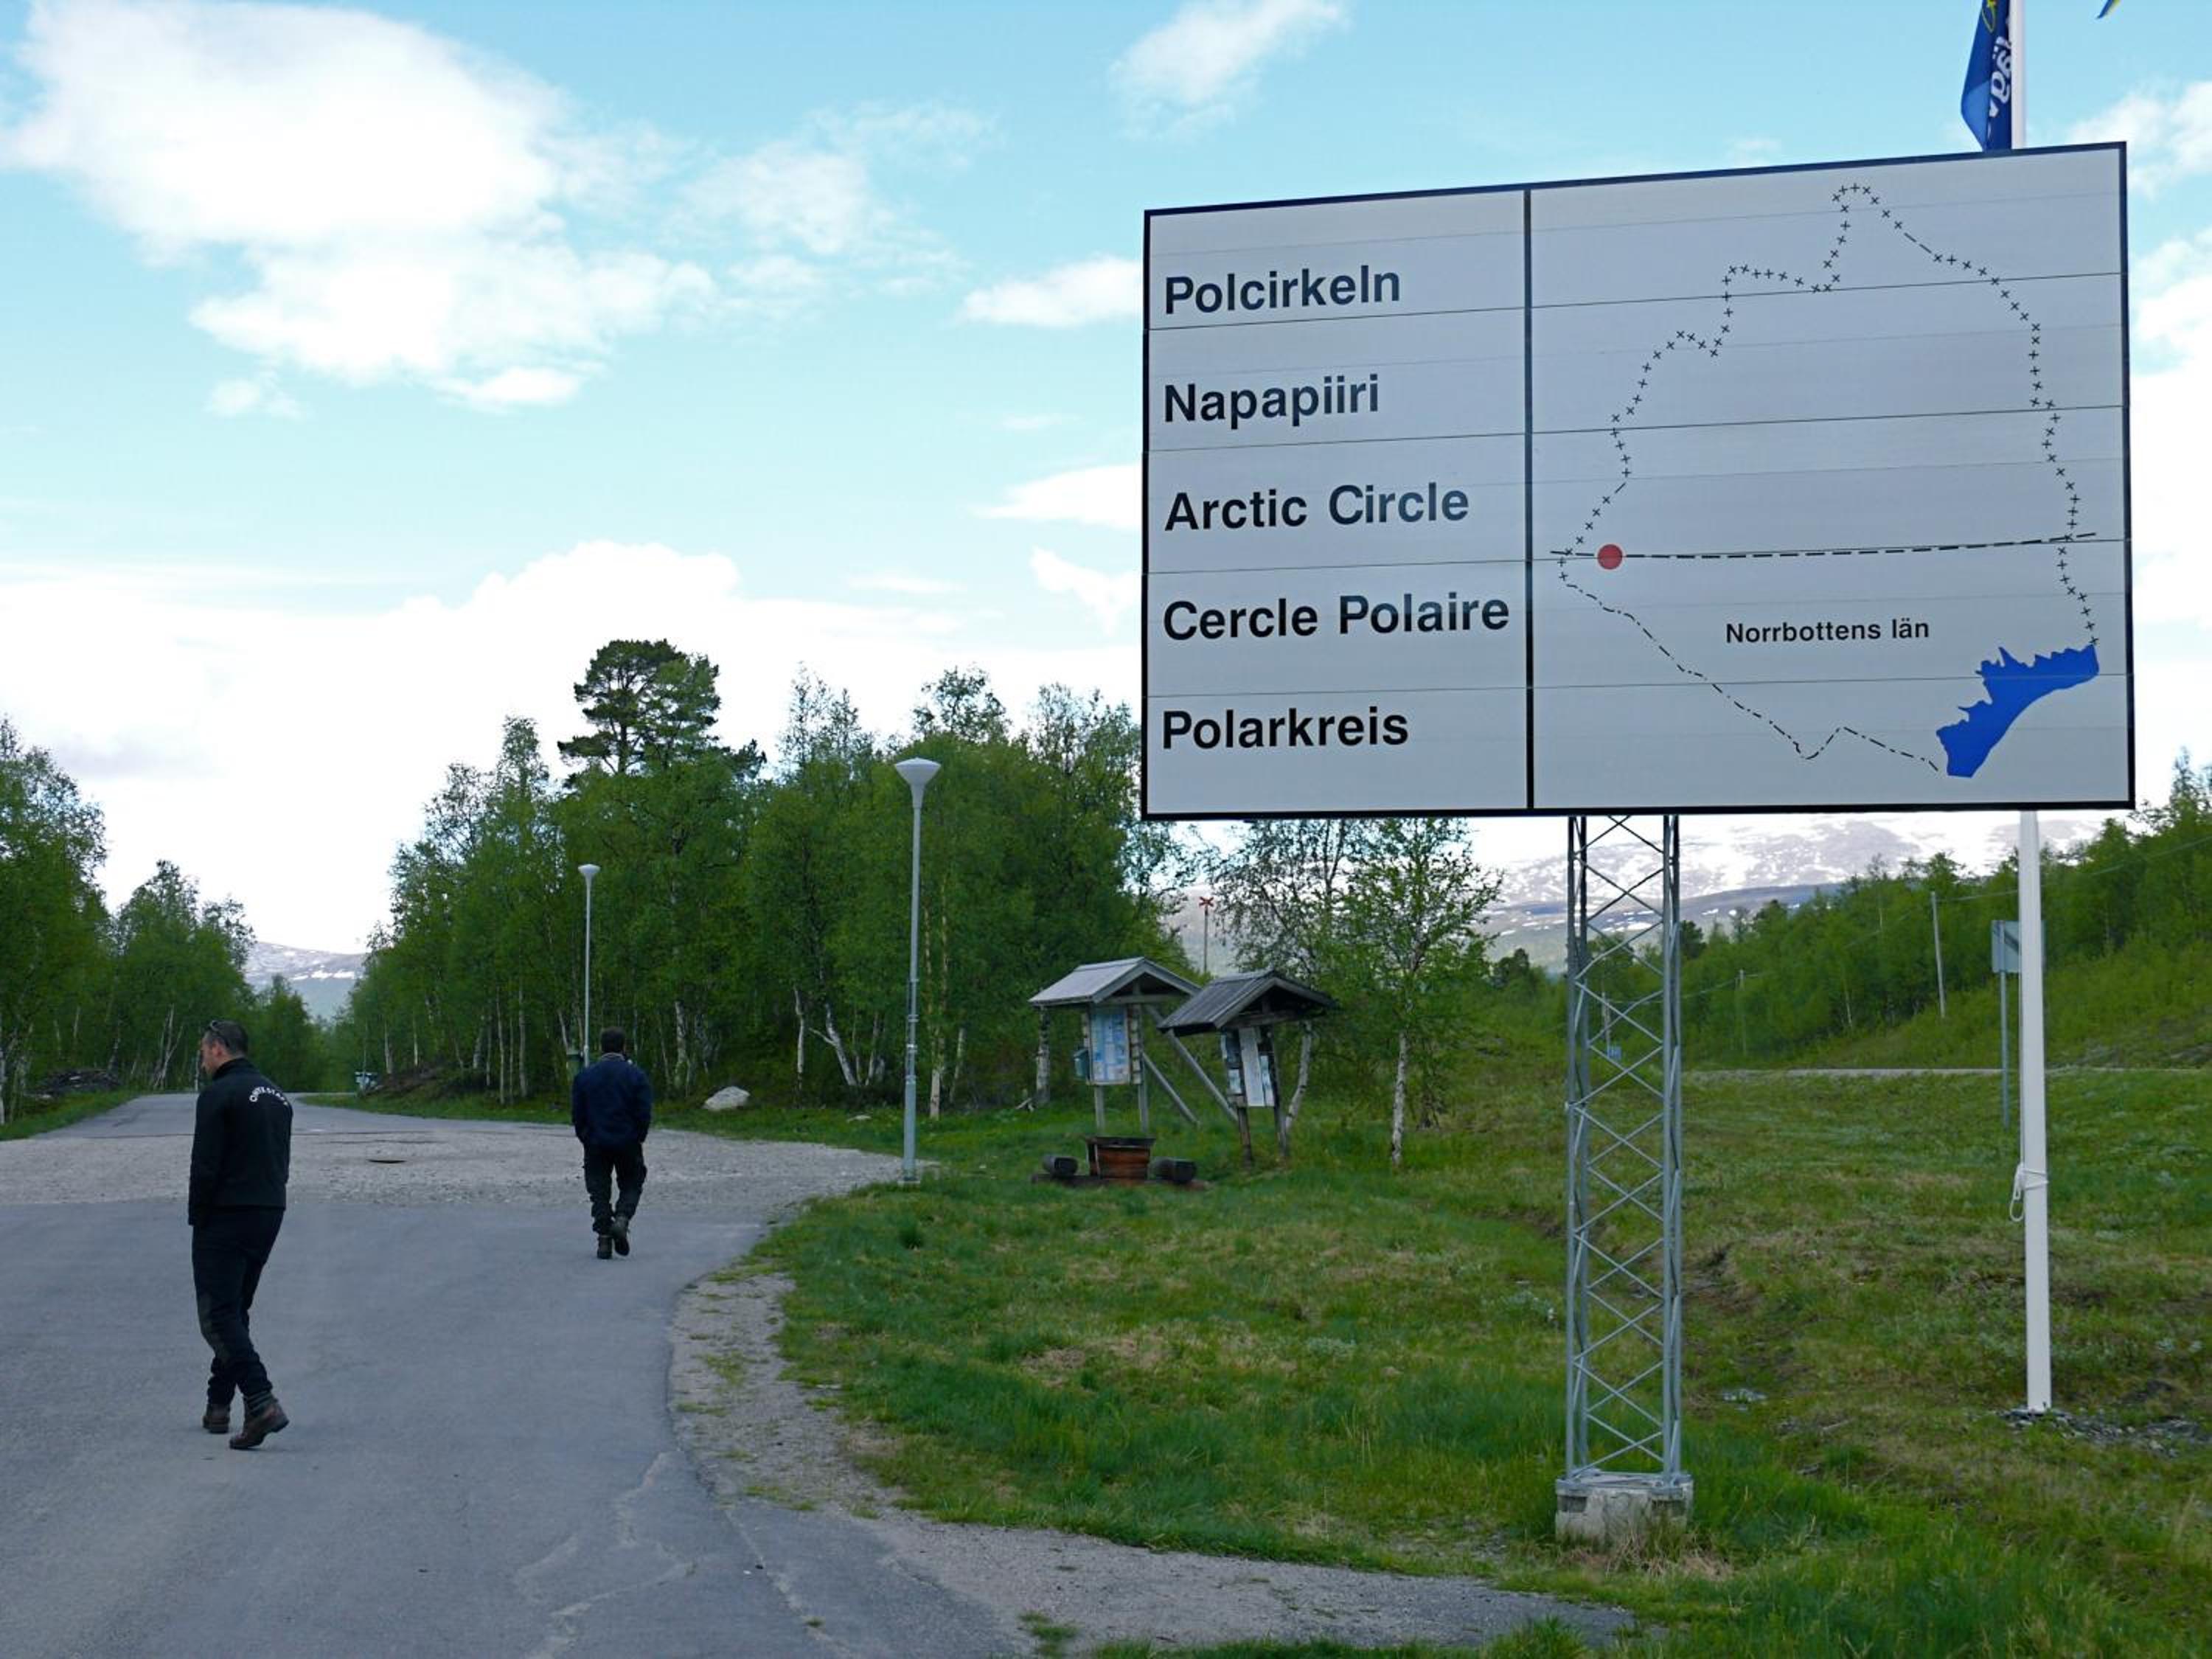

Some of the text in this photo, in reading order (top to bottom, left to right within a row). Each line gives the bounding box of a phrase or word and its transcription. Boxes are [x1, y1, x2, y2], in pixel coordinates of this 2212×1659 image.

[1166, 265, 1399, 315] Polcirkeln
[1165, 373, 1378, 431] Napapiiri
[1164, 482, 1468, 532] Arctic Circle
[1164, 591, 1509, 641] Cercle Polaire
[1726, 617, 1929, 644] Norrbottens län
[1163, 706, 1408, 750] Polarkreis
